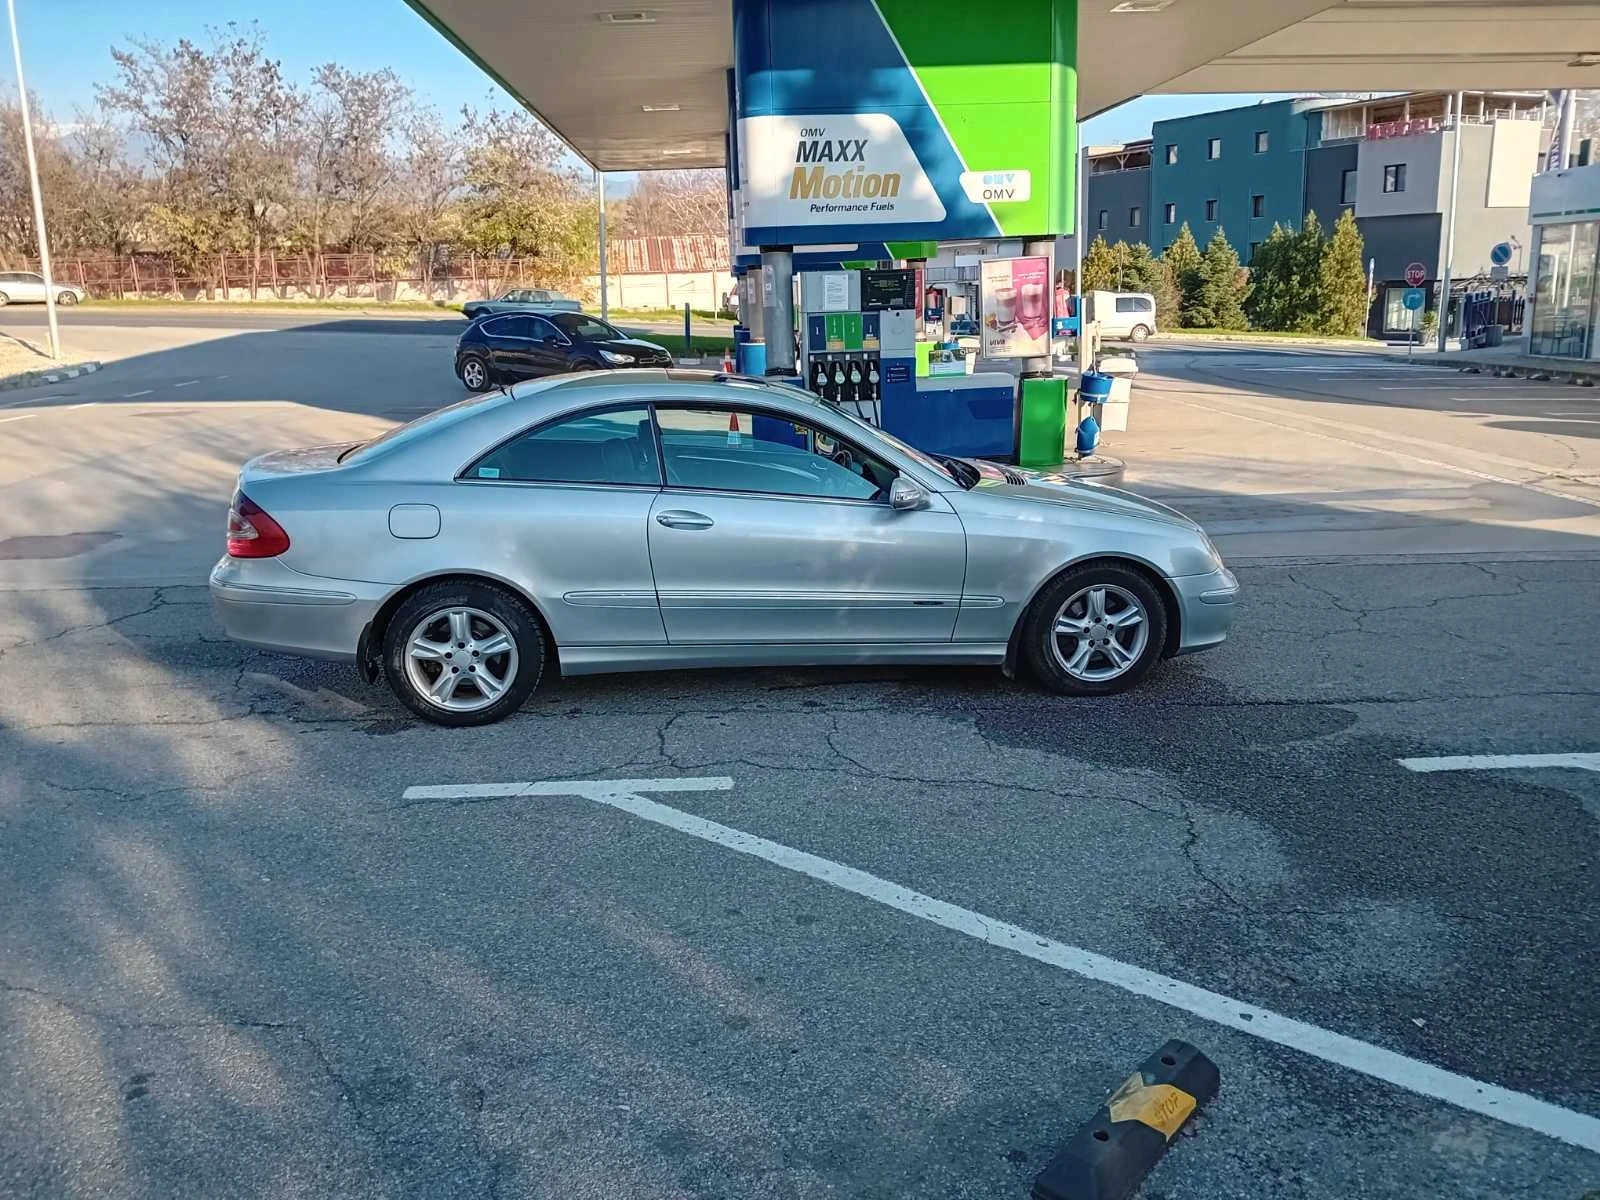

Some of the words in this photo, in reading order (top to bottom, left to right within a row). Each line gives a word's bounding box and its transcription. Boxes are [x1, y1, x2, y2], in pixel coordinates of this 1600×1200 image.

[800, 128, 825, 138] OMV
[796, 139, 868, 162] MAXX
[790, 165, 901, 200] Motion
[983, 189, 1015, 200] OMV
[810, 204, 868, 213] Performance
[870, 202, 895, 211] Fuels
[1407, 270, 1425, 279] STOP
